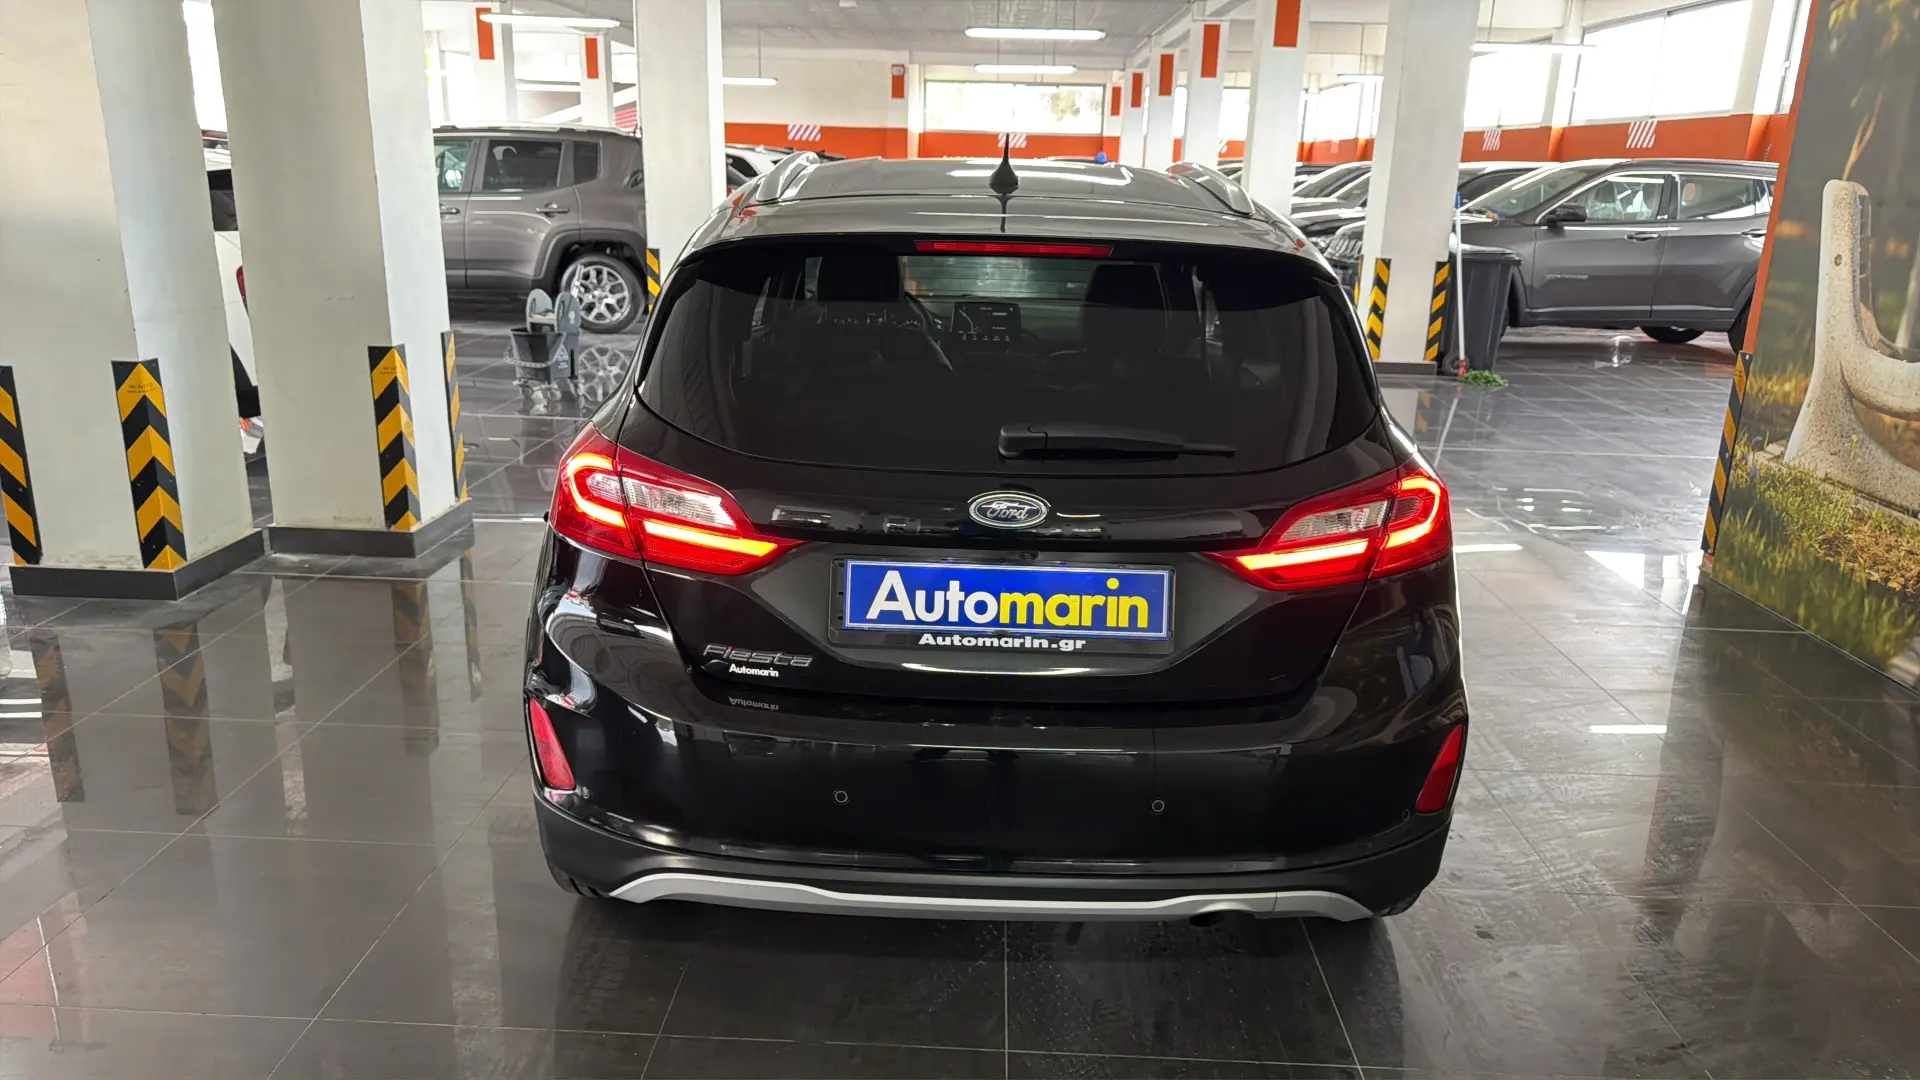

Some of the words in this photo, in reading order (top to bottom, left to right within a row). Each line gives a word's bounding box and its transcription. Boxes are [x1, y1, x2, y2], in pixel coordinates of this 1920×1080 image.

[981, 500, 1038, 520] Ford
[865, 570, 1149, 629] Automarin
[918, 633, 1087, 652] Automarin.gr
[702, 644, 814, 668] Fiesta
[728, 663, 780, 678] Automarin
